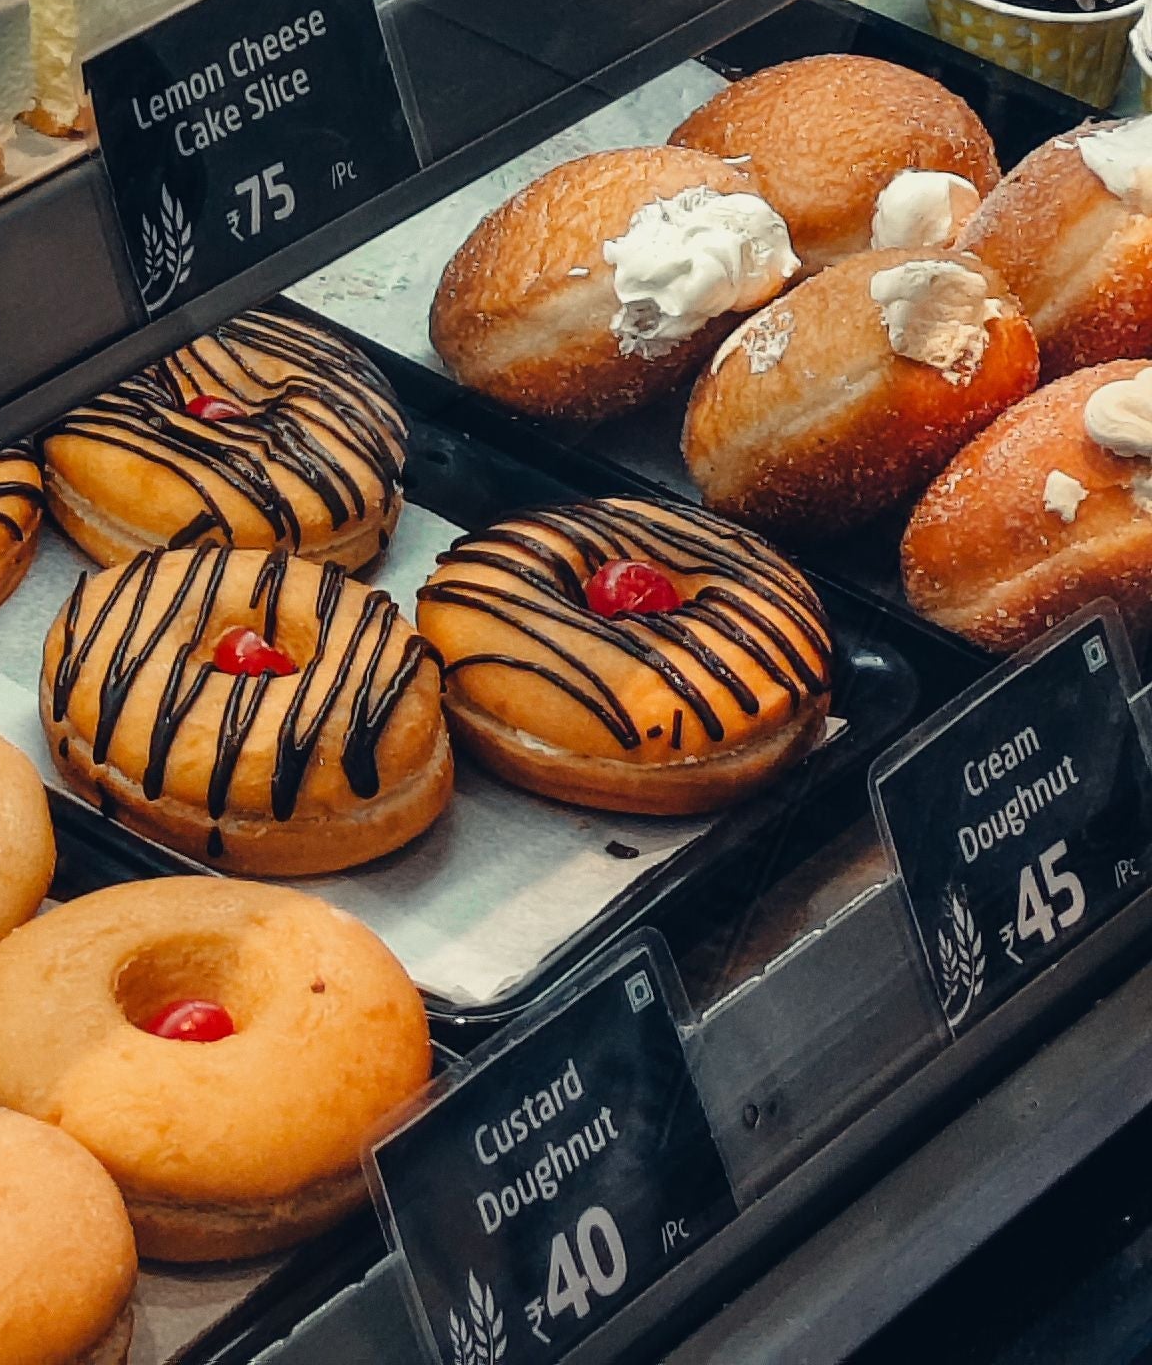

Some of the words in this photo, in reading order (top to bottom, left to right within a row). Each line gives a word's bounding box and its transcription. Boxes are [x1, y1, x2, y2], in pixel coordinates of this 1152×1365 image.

[132, 62, 225, 130] Lemon
[229, 9, 327, 79] Cheese
[175, 102, 243, 157] Cake
[246, 68, 310, 120] Slice
[958, 754, 1079, 864] Doughnut
[964, 726, 1041, 797] Cream
[476, 1059, 585, 1165] Custard
[476, 1107, 619, 1235] Doughnut
